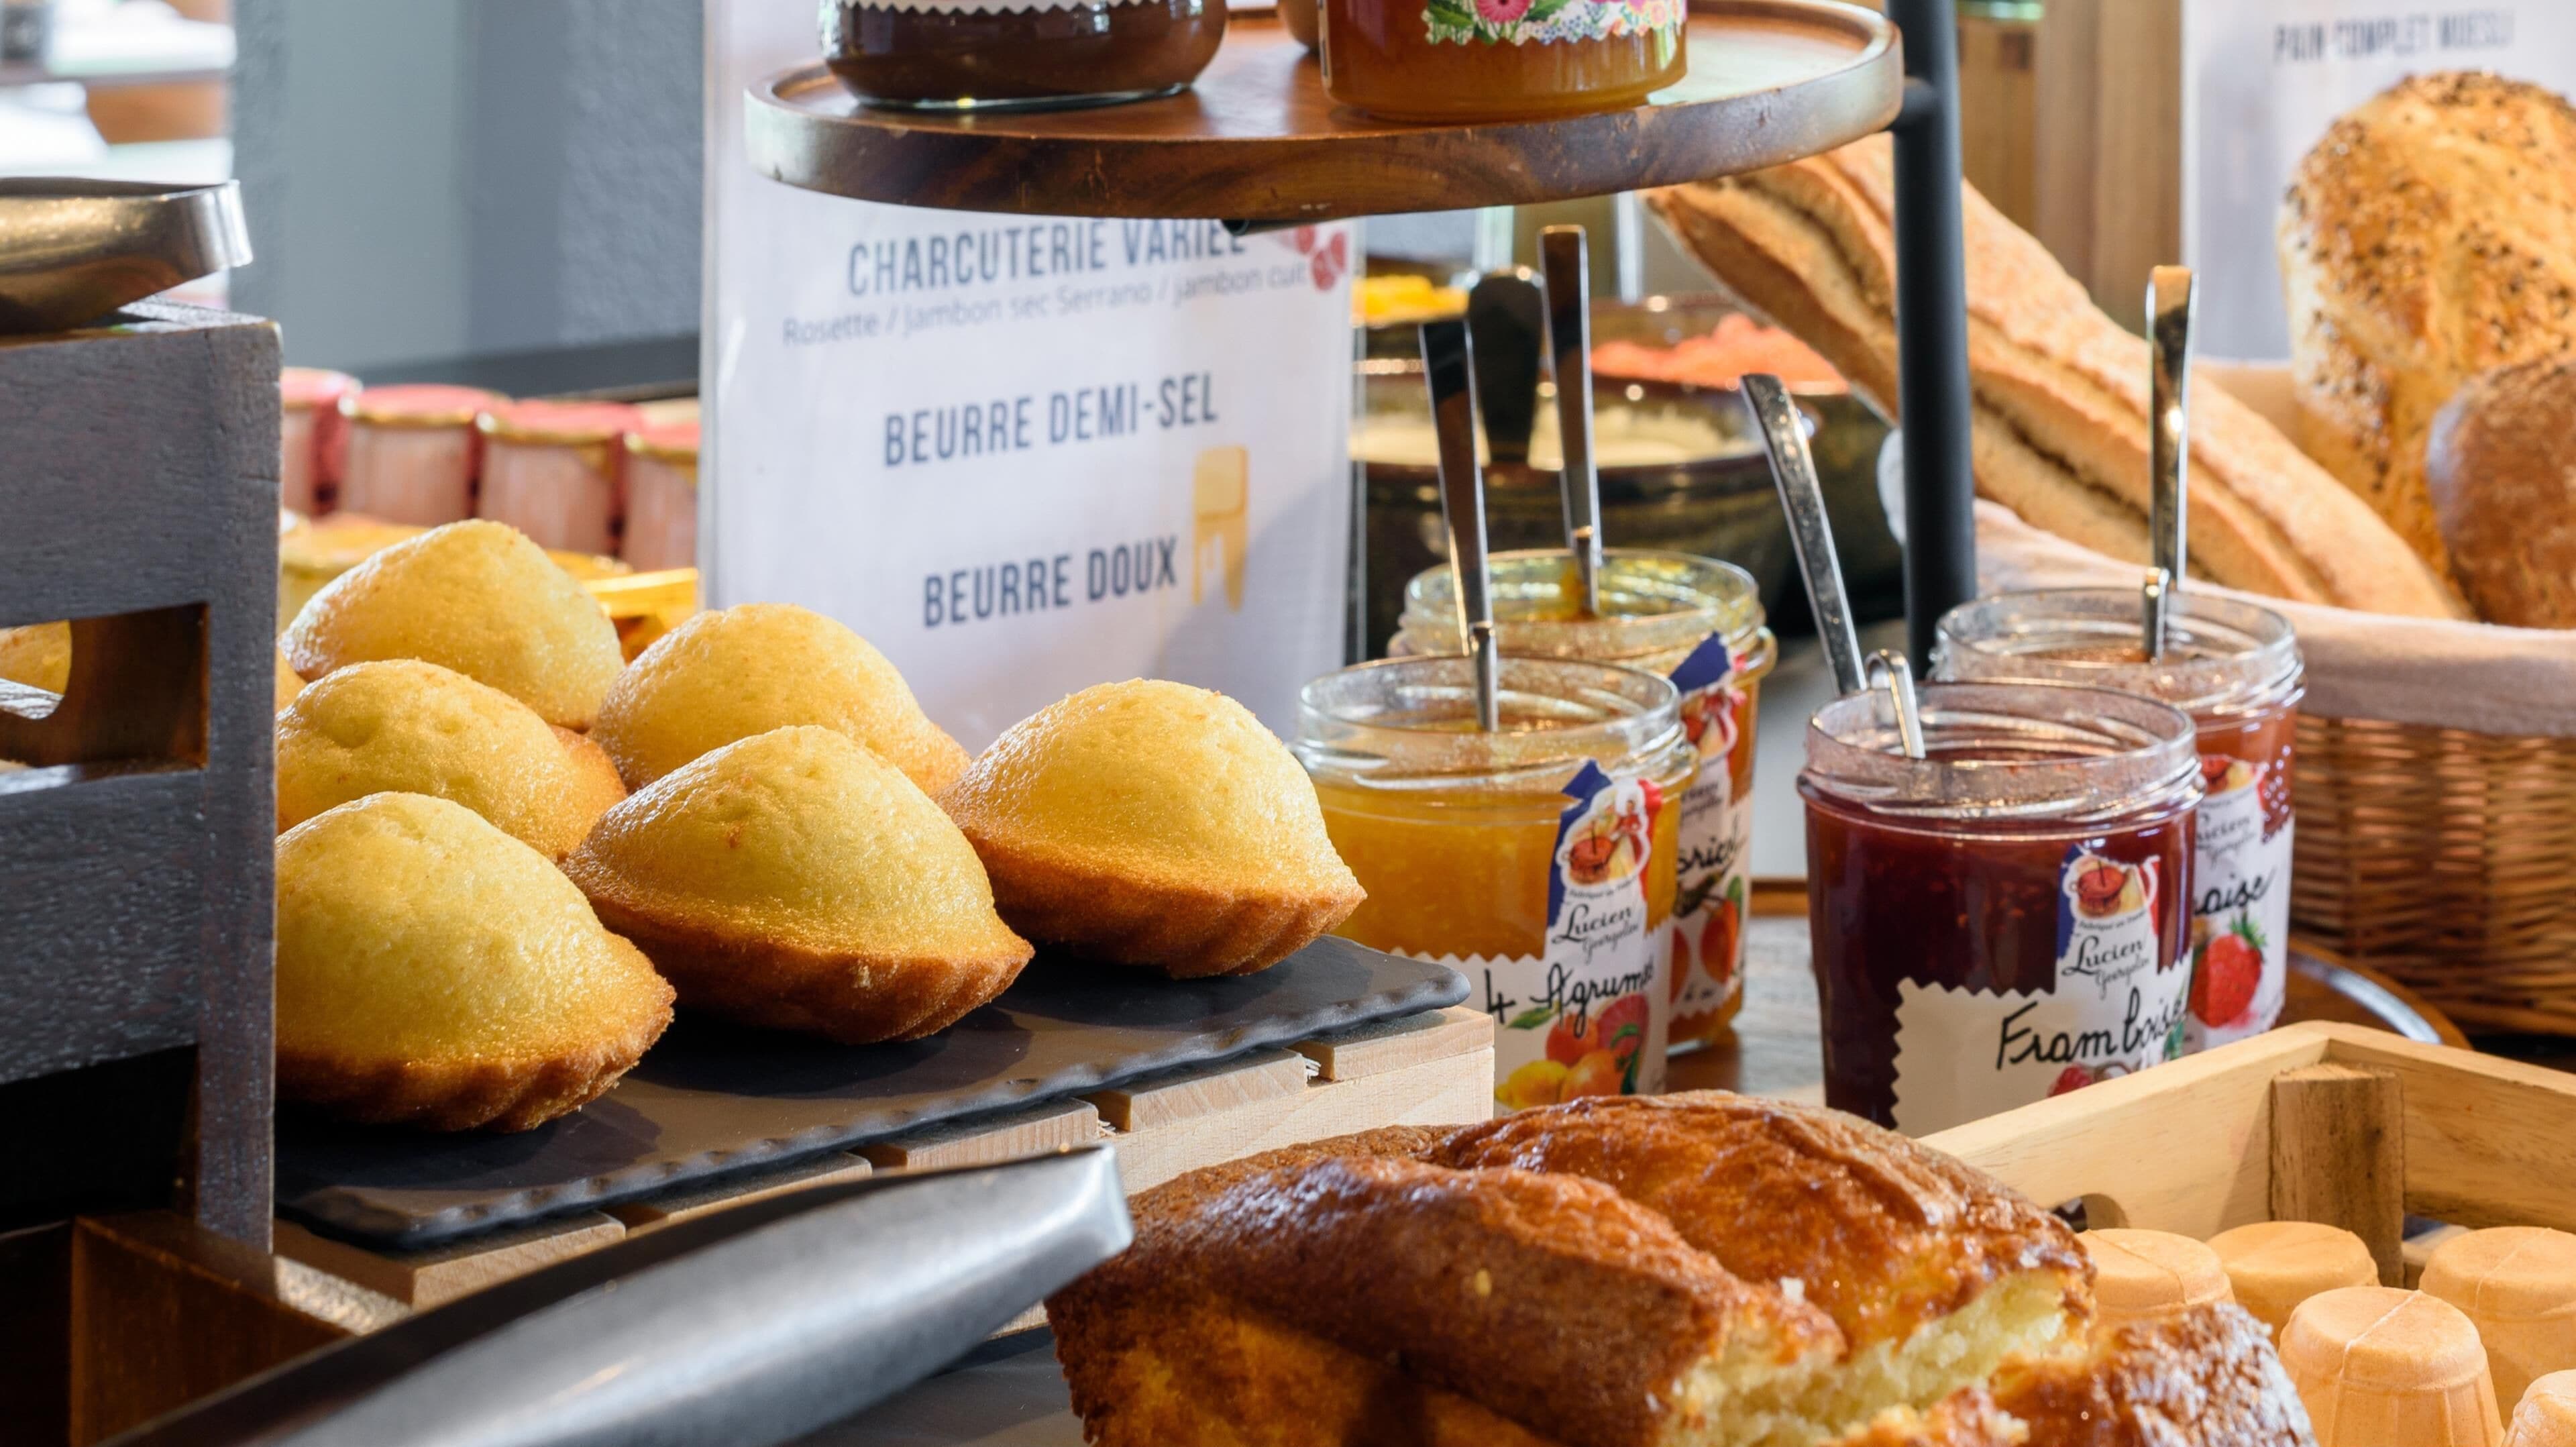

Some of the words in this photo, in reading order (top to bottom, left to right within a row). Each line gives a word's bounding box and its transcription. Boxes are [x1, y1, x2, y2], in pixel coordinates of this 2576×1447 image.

[848, 220, 1106, 296] CHARCUTERIE
[783, 313, 877, 346] Rosette
[1011, 292, 1046, 318] sec
[1057, 283, 1152, 316] Serrano
[885, 396, 1034, 466] BEURRE
[1049, 372, 1219, 444] DEMI-SEL
[924, 553, 1072, 628] BEURRE
[1087, 535, 1178, 602] DOUX
[1552, 904, 1631, 944] Lucien
[2061, 935, 2143, 976] Lucien
[1485, 968, 1517, 1024] 4
